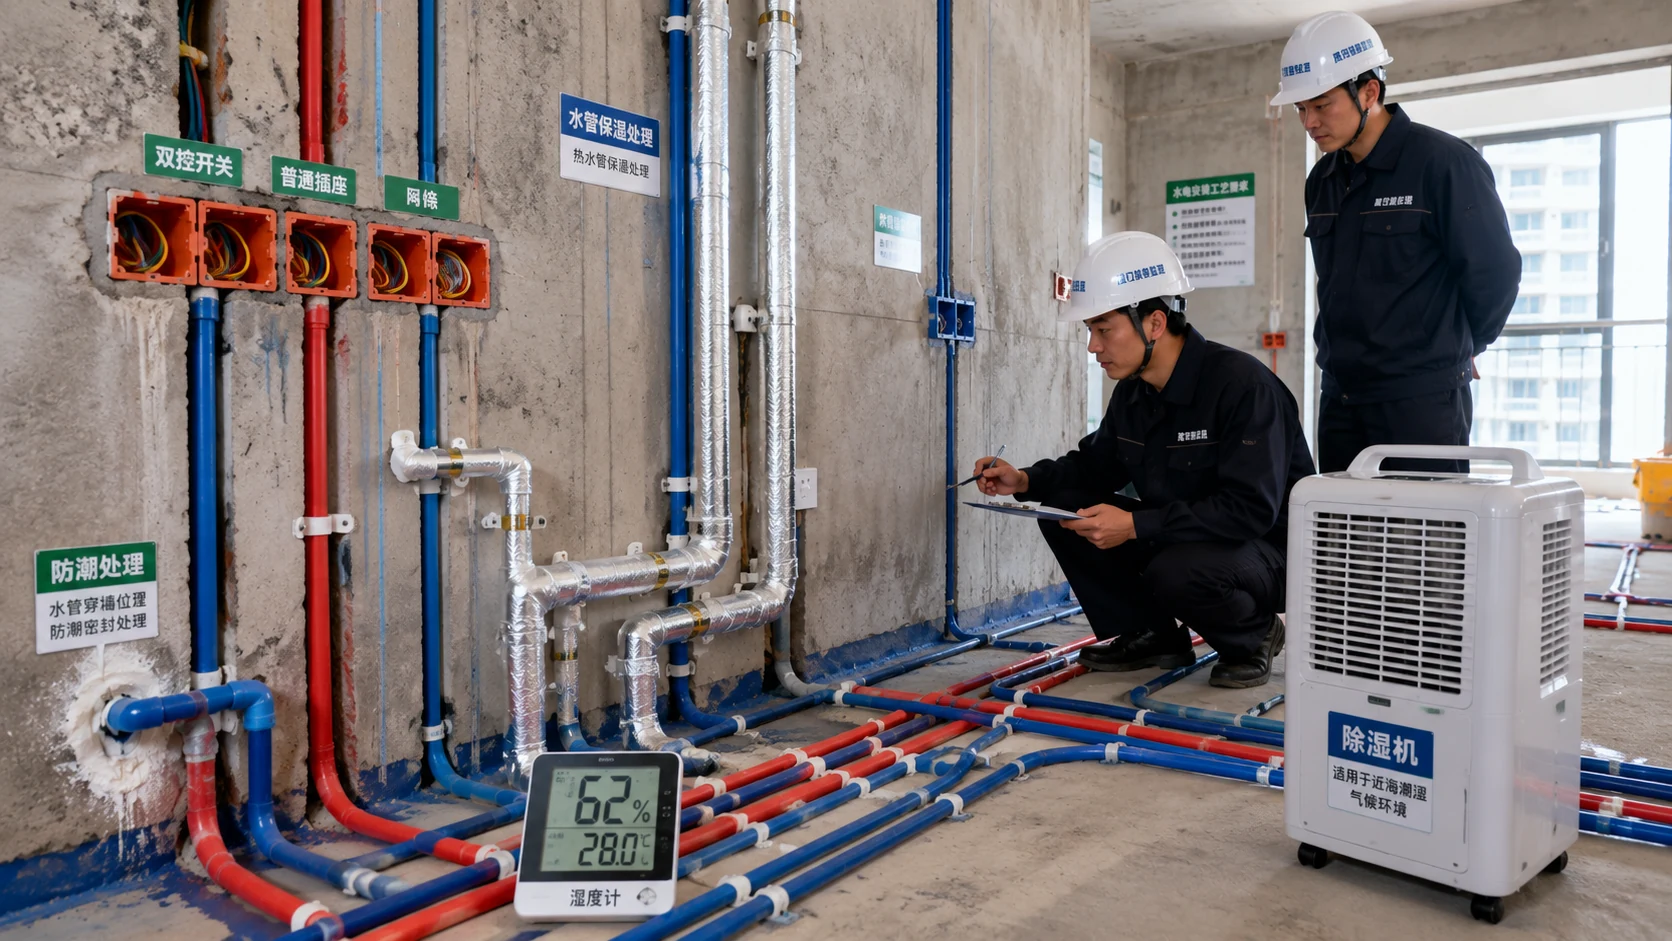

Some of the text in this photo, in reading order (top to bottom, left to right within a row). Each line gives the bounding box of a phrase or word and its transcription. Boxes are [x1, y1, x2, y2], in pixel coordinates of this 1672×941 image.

[155, 145, 233, 178] 双控开关
[280, 166, 348, 196] 普通插座
[51, 552, 144, 585] 防潮处理
[1342, 724, 1418, 766] 除湿机
[1350, 789, 1407, 819] 气候环境
[569, 888, 621, 908] 湿度计
